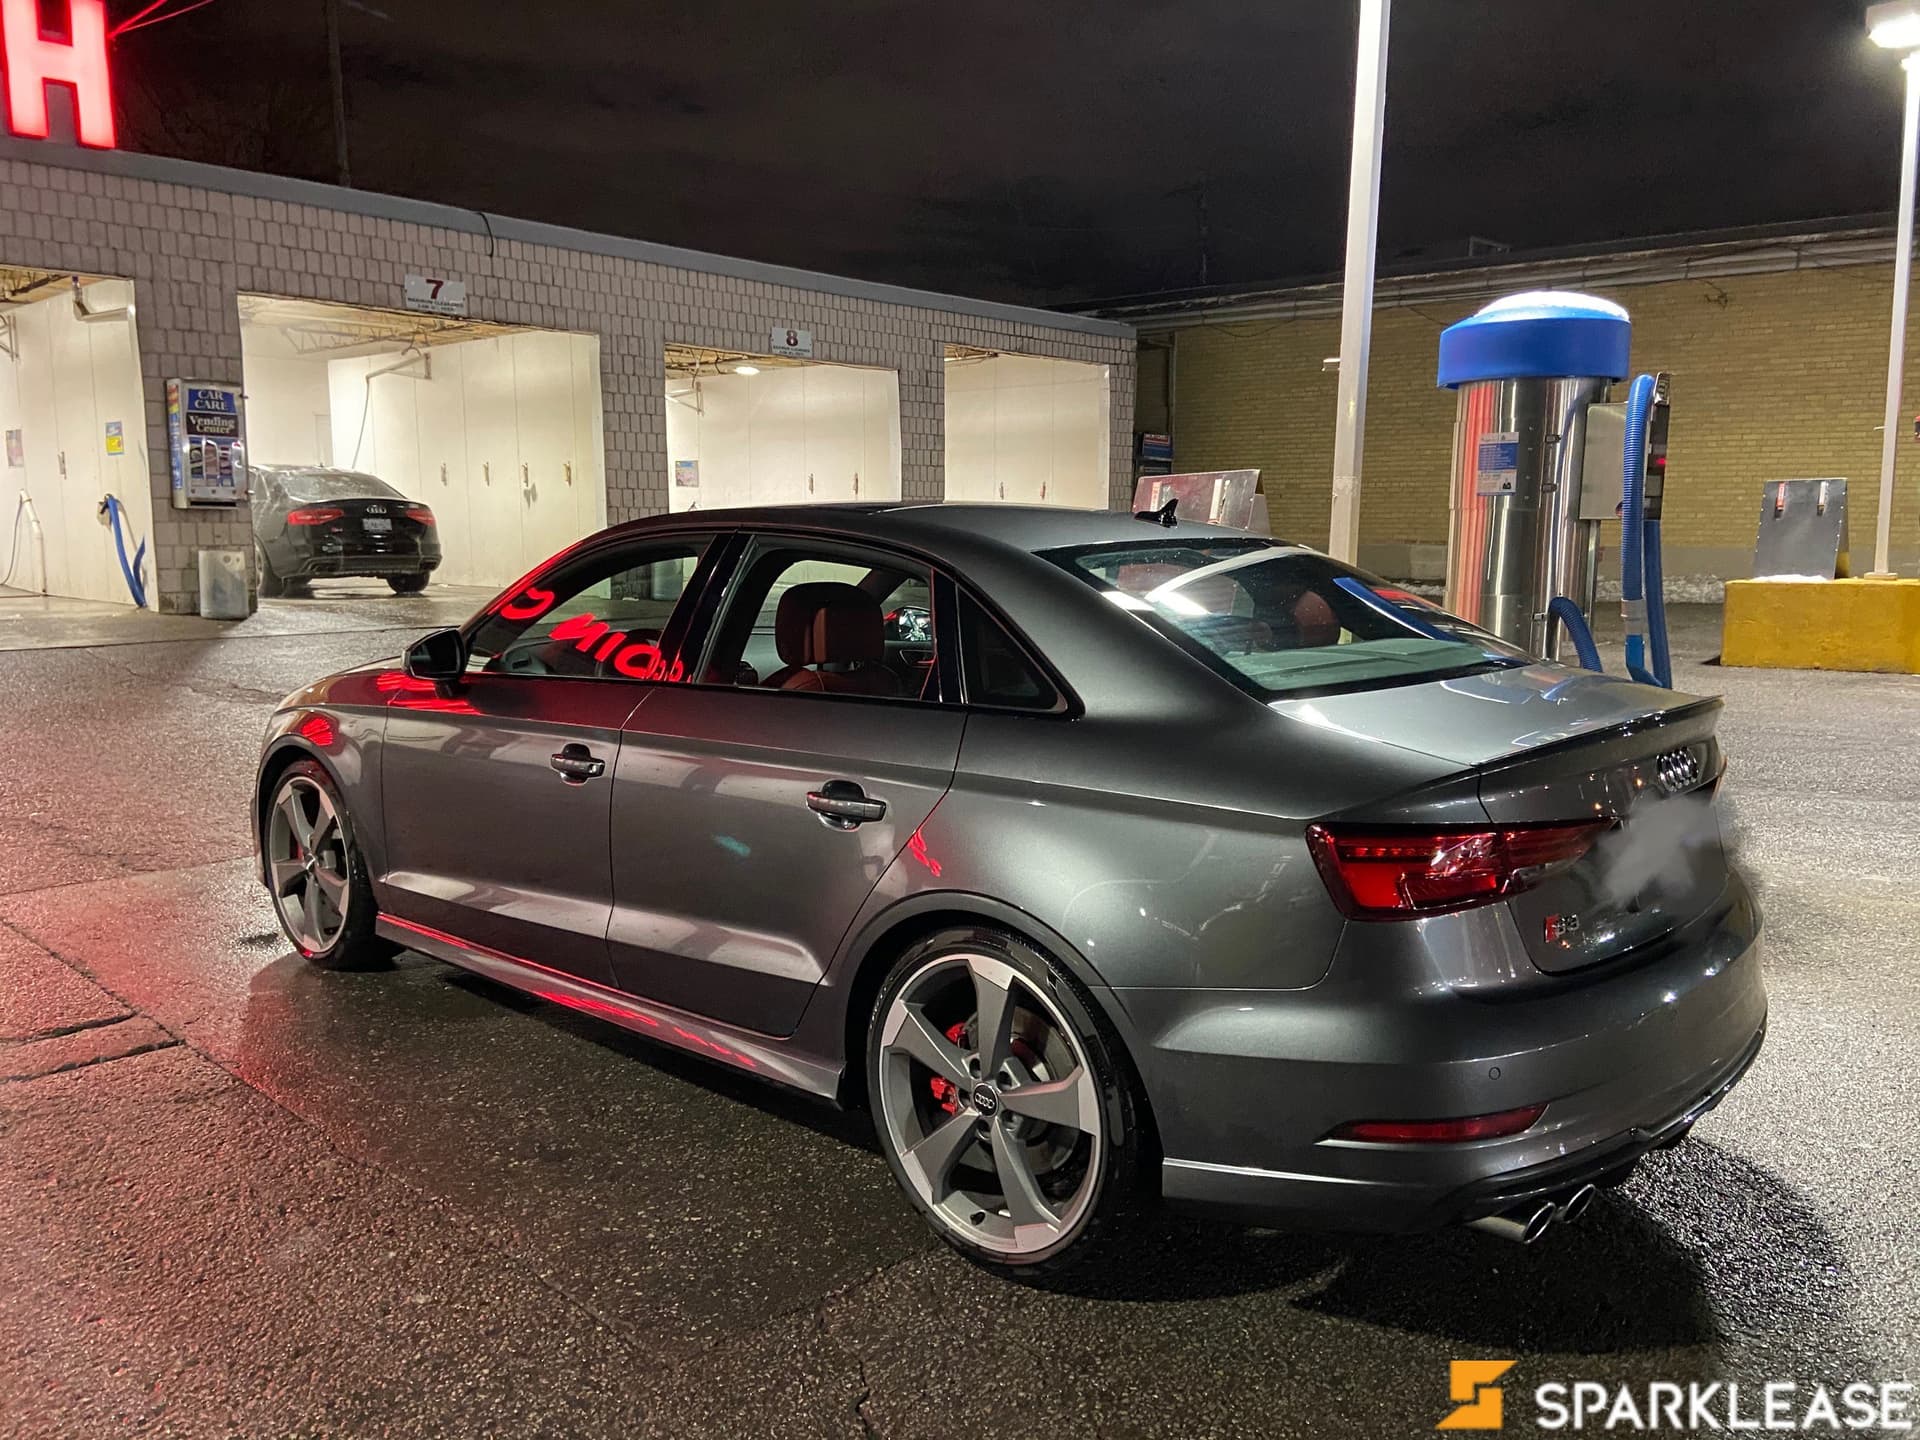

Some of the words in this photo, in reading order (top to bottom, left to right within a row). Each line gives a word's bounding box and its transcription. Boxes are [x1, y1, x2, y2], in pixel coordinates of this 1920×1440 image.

[425, 279, 444, 299] 7
[786, 330, 798, 346] 8
[198, 390, 224, 400] CAR
[189, 415, 235, 430] Vending
[196, 424, 231, 434] Center
